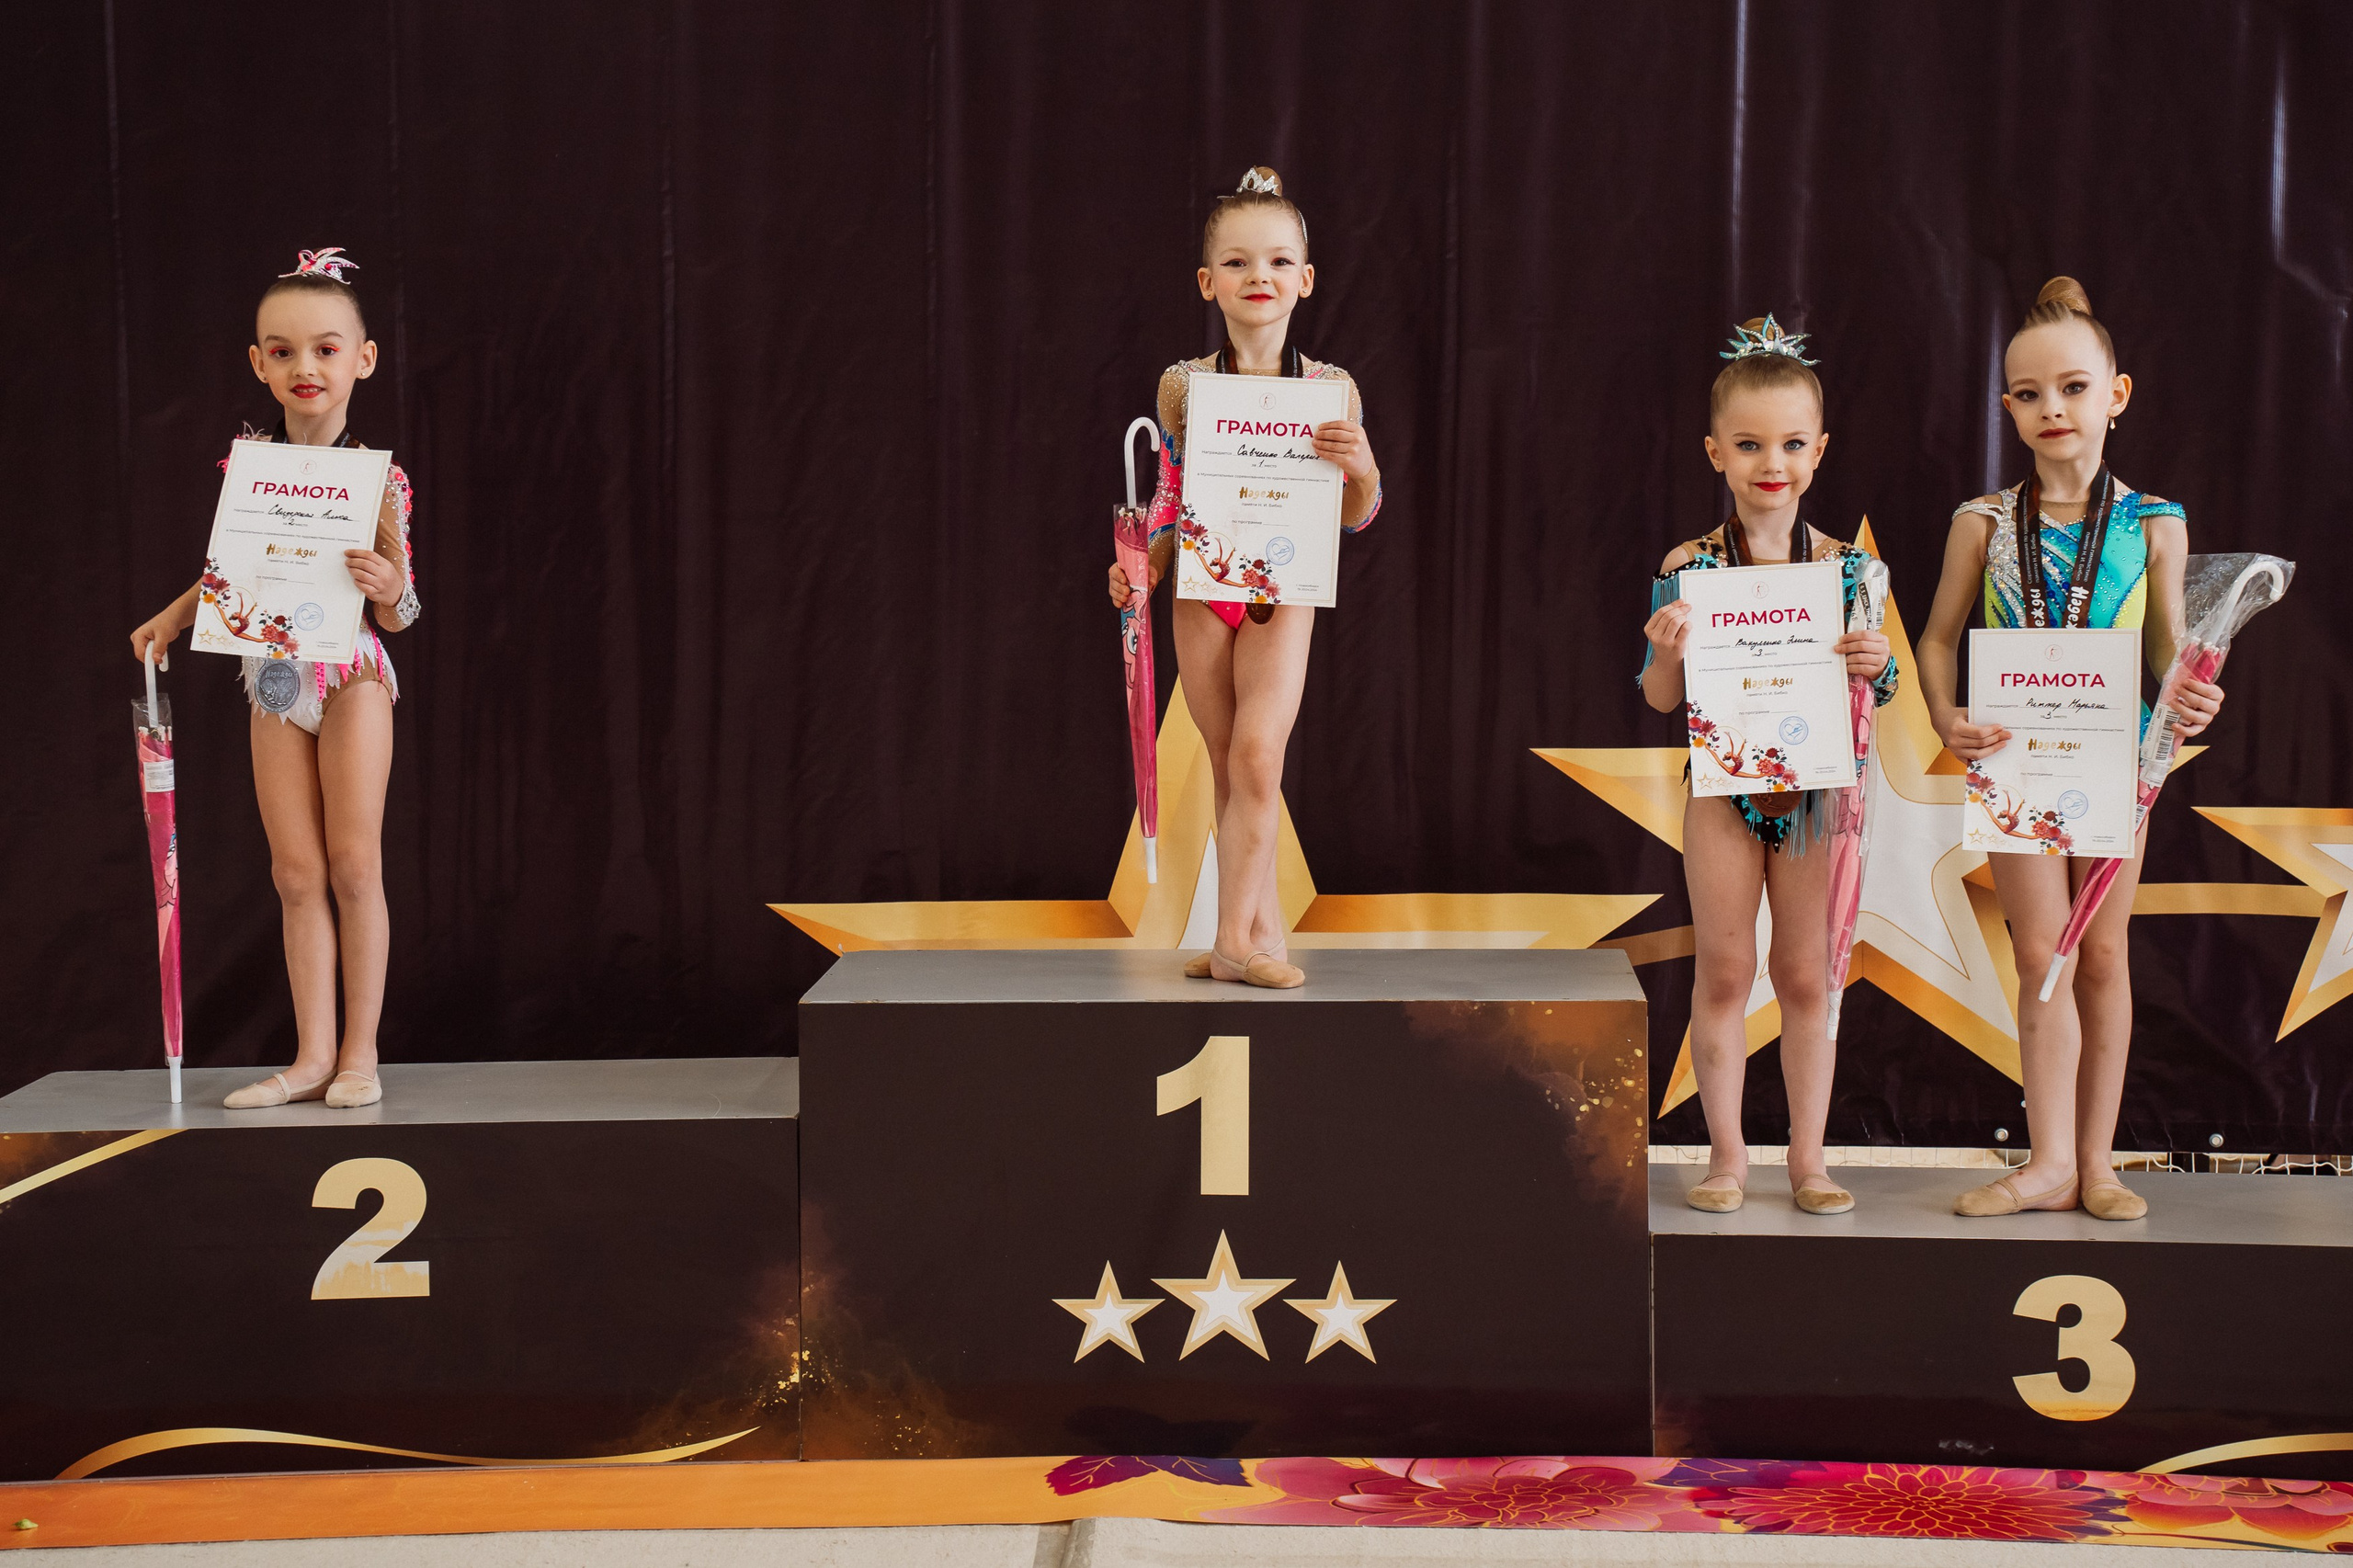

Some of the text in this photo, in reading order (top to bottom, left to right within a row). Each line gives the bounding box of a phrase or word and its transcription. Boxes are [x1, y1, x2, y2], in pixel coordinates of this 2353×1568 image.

[1216, 419, 1313, 437] ГРАМОТА
[252, 482, 349, 501] ГРАМОТА
[1238, 486, 1289, 501] Надежды
[266, 543, 318, 558] Надежды
[1711, 608, 1811, 627] ГРАМОТА
[2029, 588, 2046, 629] ежды
[1743, 677, 1793, 689] Надежды
[2000, 673, 2106, 687] ГРАМОТА
[2044, 710, 2051, 719] 3
[2028, 738, 2081, 752] Надежды
[1156, 1035, 1250, 1195] 1
[311, 1157, 430, 1300] 2
[2012, 1275, 2136, 1422] 3
